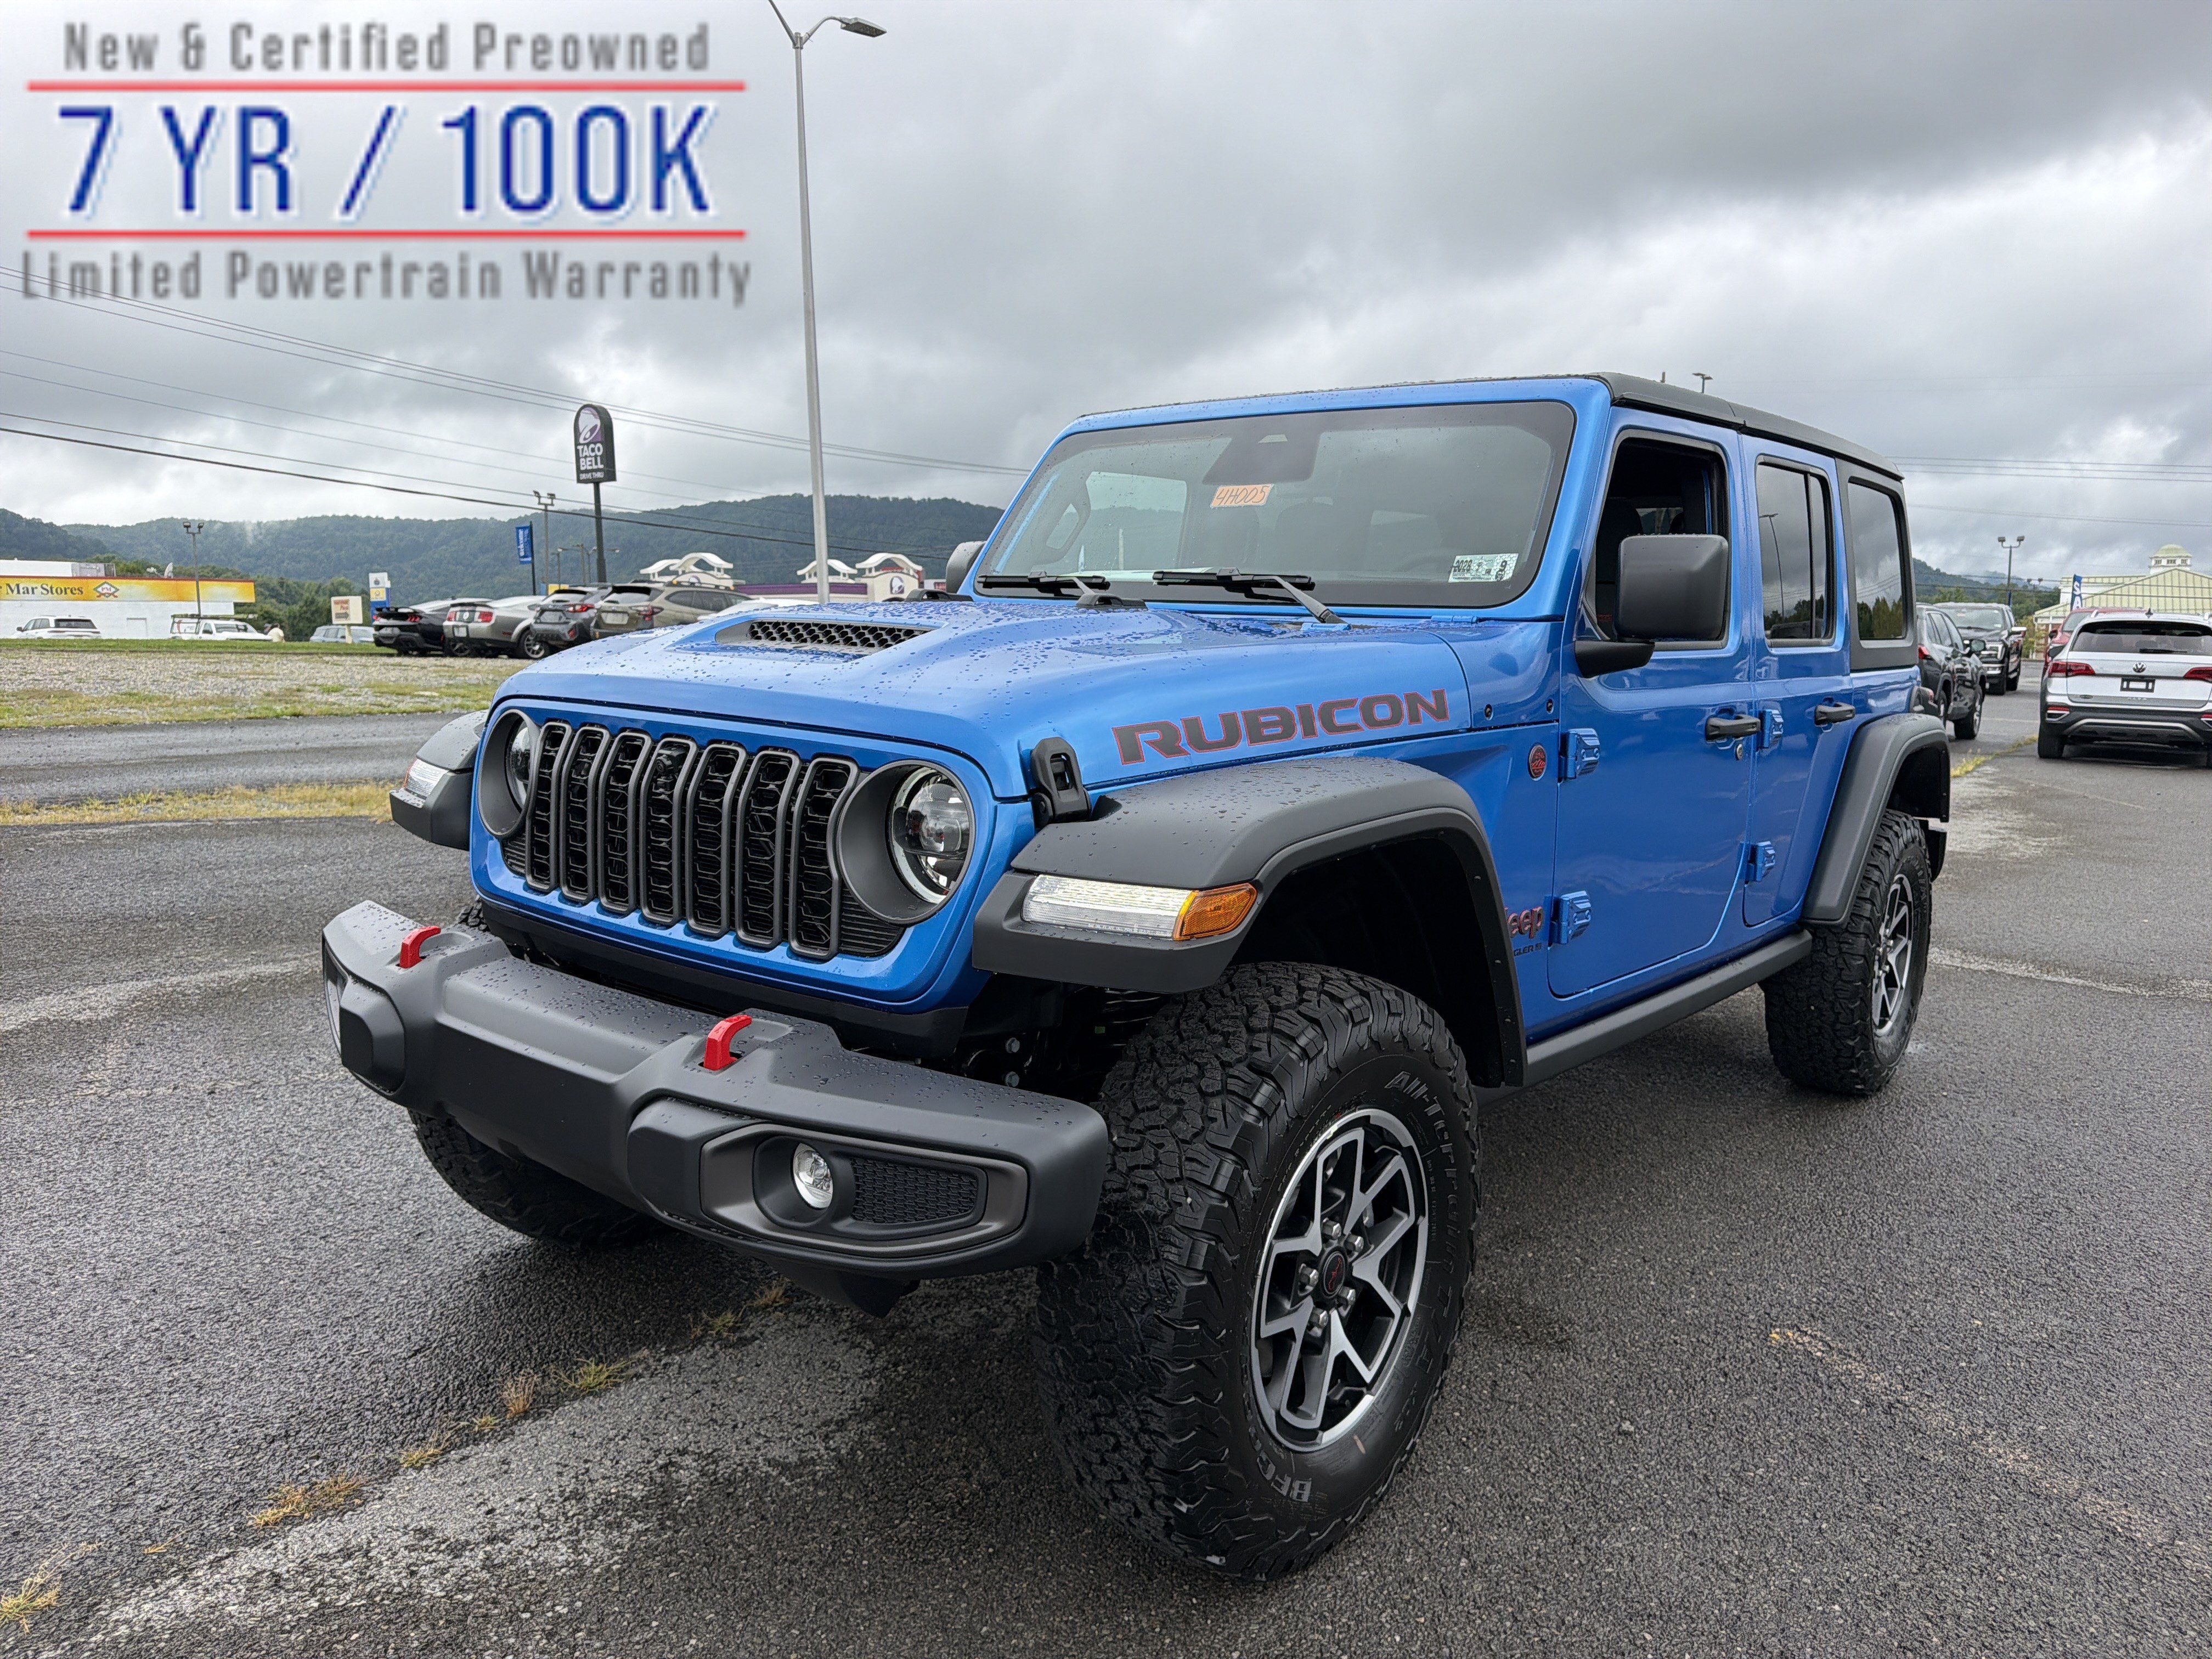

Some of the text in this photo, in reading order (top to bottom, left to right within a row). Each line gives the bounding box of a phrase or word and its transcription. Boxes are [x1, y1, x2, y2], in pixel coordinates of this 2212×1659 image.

[577, 443, 603, 457] TACO
[580, 456, 603, 470] BELL
[5, 583, 38, 595] Mar
[40, 583, 83, 596] Stores
[1112, 689, 1449, 766] RUBICON
[1504, 906, 1544, 939] eep
